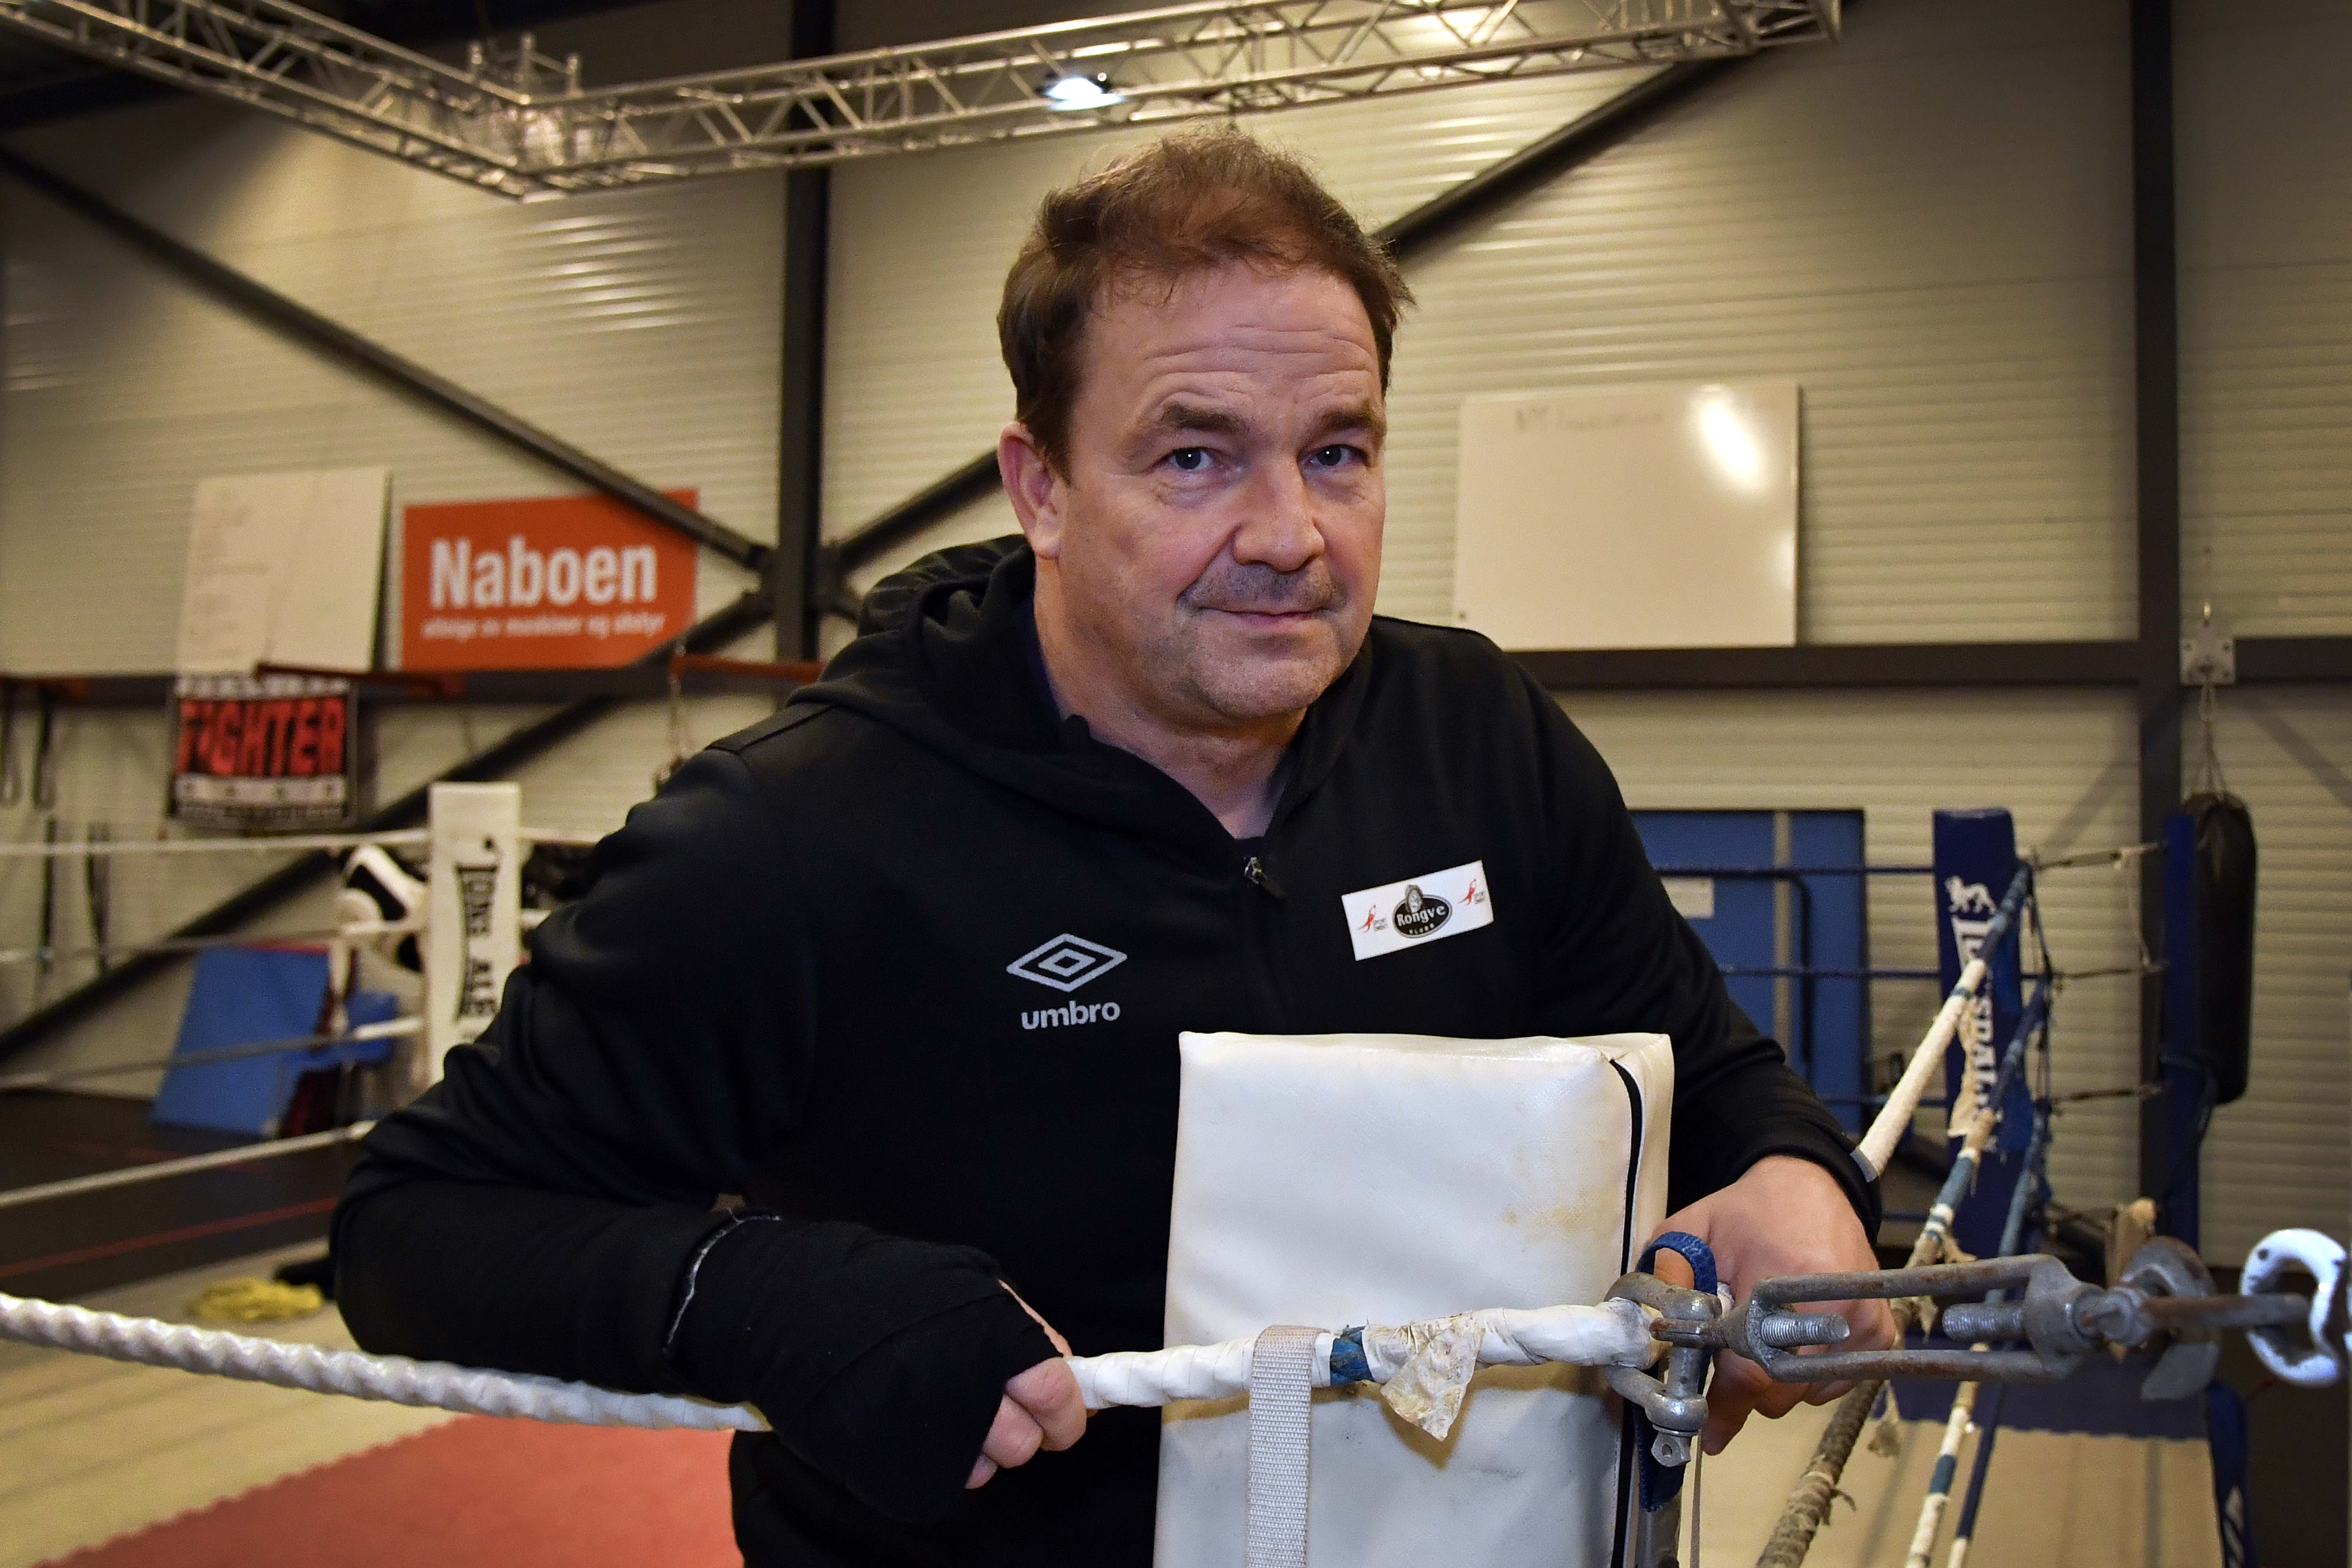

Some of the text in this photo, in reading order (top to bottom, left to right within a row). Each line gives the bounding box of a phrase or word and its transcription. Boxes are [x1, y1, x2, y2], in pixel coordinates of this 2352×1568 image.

[428, 535, 657, 610] Naboen
[175, 698, 346, 776] FIGHTER
[1396, 906, 1446, 926] Rongve
[1021, 1000, 1121, 1030] umbro
